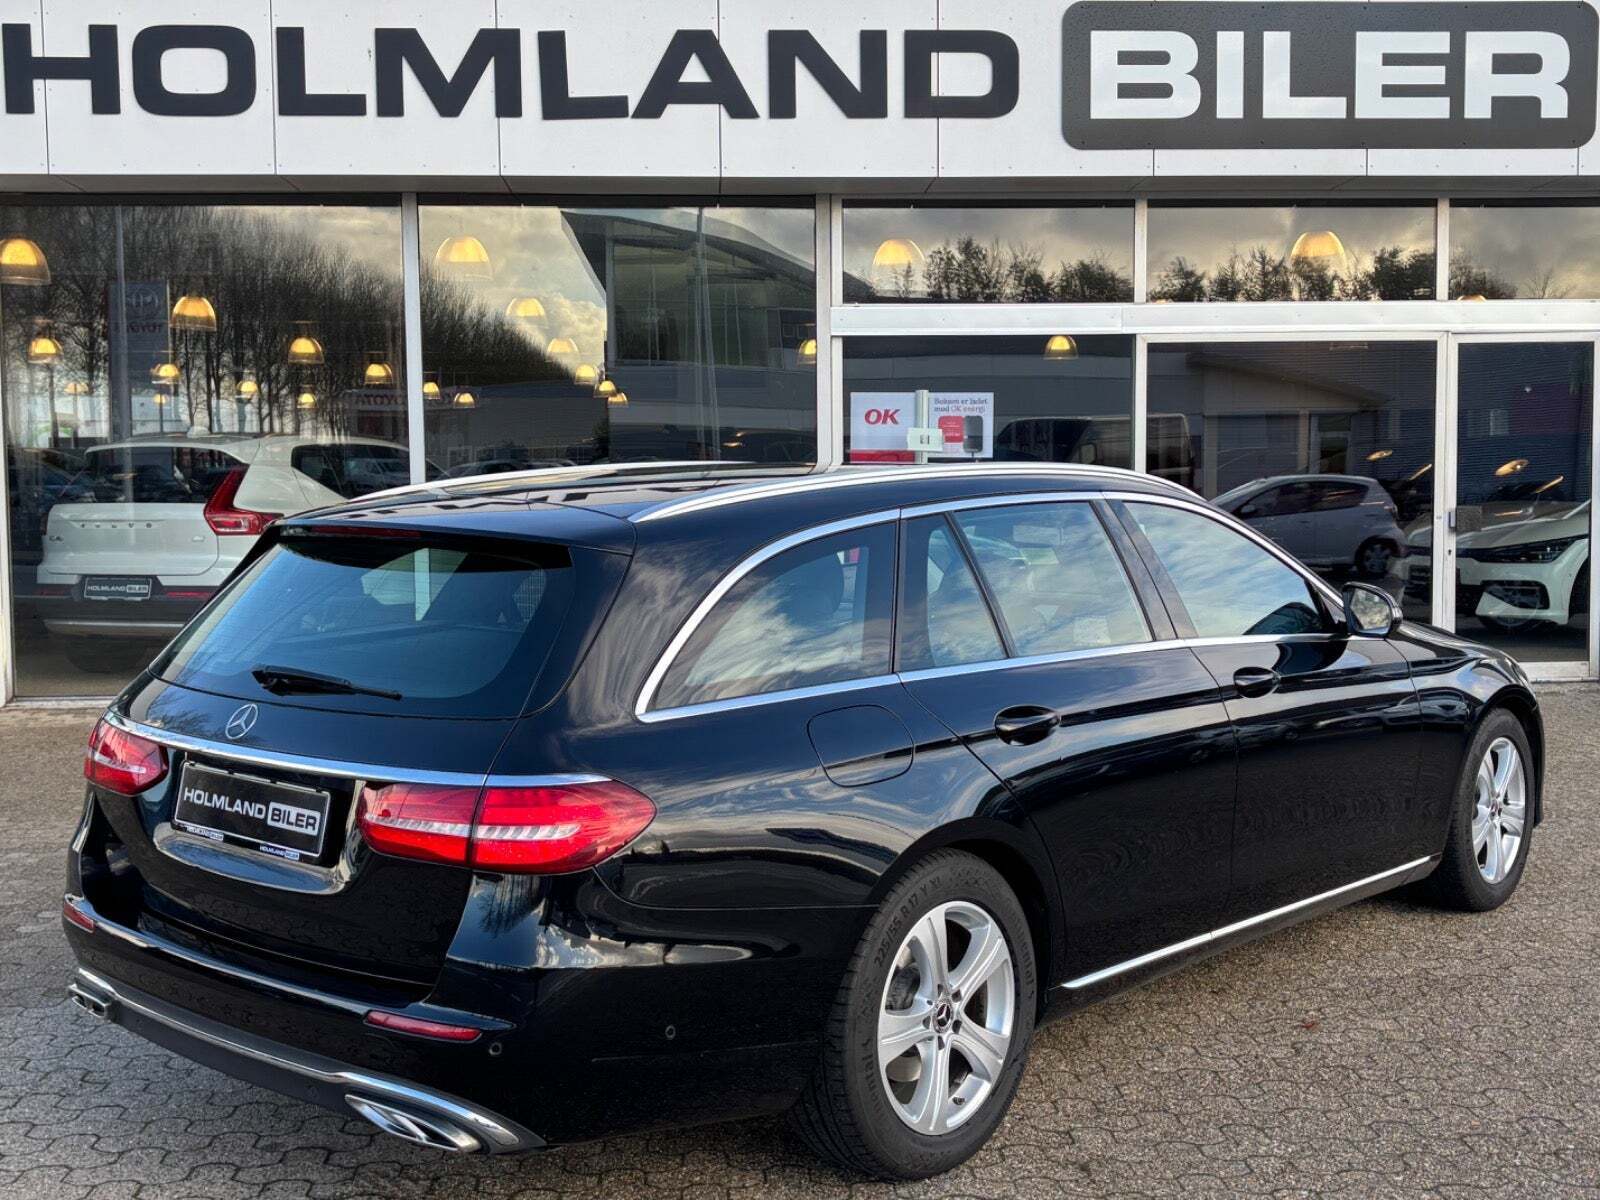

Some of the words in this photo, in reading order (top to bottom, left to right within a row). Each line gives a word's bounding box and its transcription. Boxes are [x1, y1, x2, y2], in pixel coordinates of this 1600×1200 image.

[1, 23, 1020, 120] HOLMLAND
[1090, 30, 1571, 120] BILER
[864, 408, 901, 425] OK
[184, 787, 266, 820] HOLMLAND
[271, 807, 317, 831] BILER
